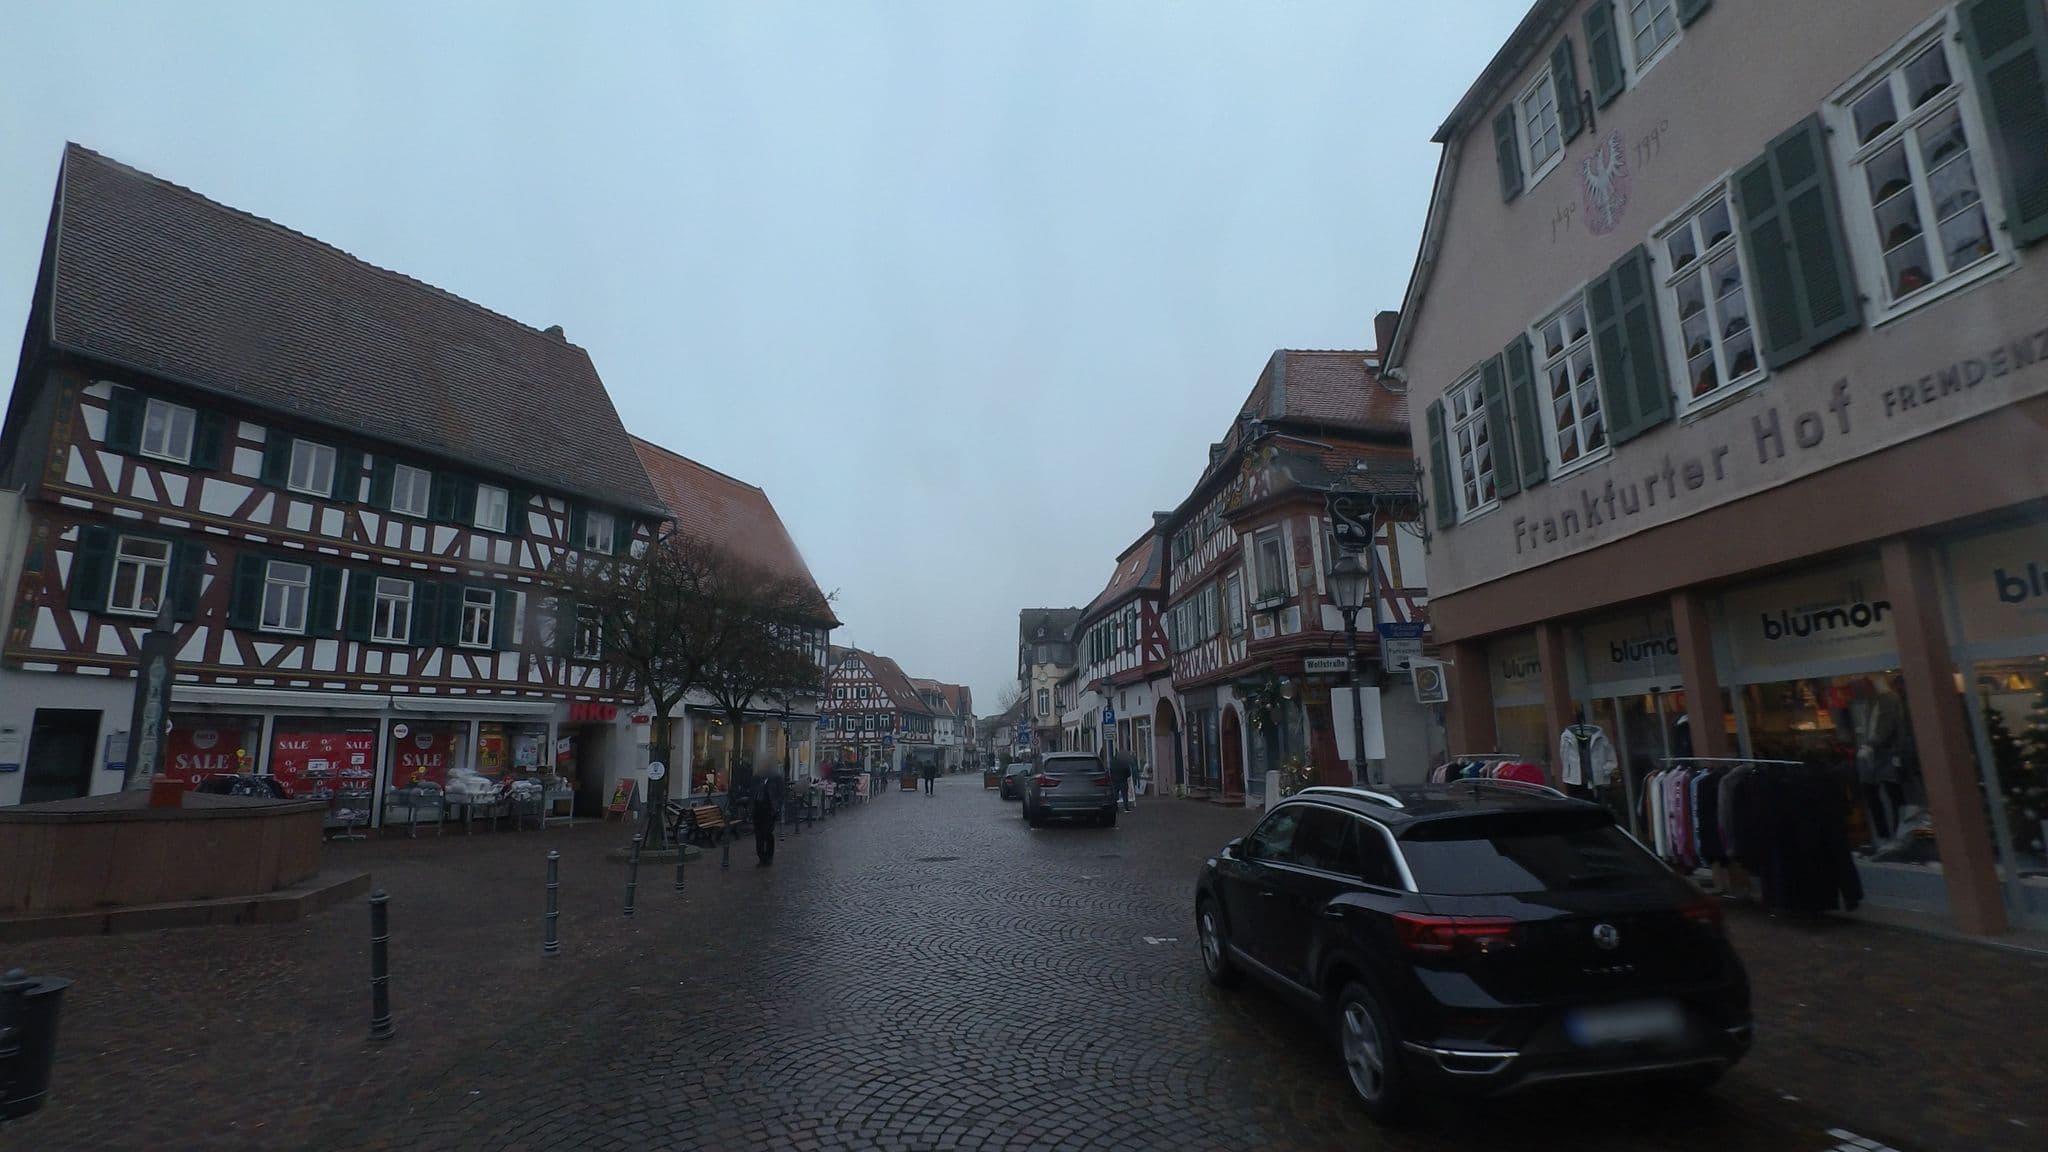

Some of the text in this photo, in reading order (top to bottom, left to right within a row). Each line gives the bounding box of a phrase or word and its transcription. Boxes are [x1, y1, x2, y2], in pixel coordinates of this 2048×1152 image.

[1512, 443, 1729, 554] Frankfurter
[1751, 377, 1851, 464] Hof
[1994, 562, 2048, 603] bl
[1761, 600, 1892, 640] blumor
[1105, 711, 1113, 723] P
[279, 740, 309, 750] SALE
[344, 740, 373, 750] SALE
[175, 753, 230, 770] SALE
[401, 752, 441, 767] SALE
